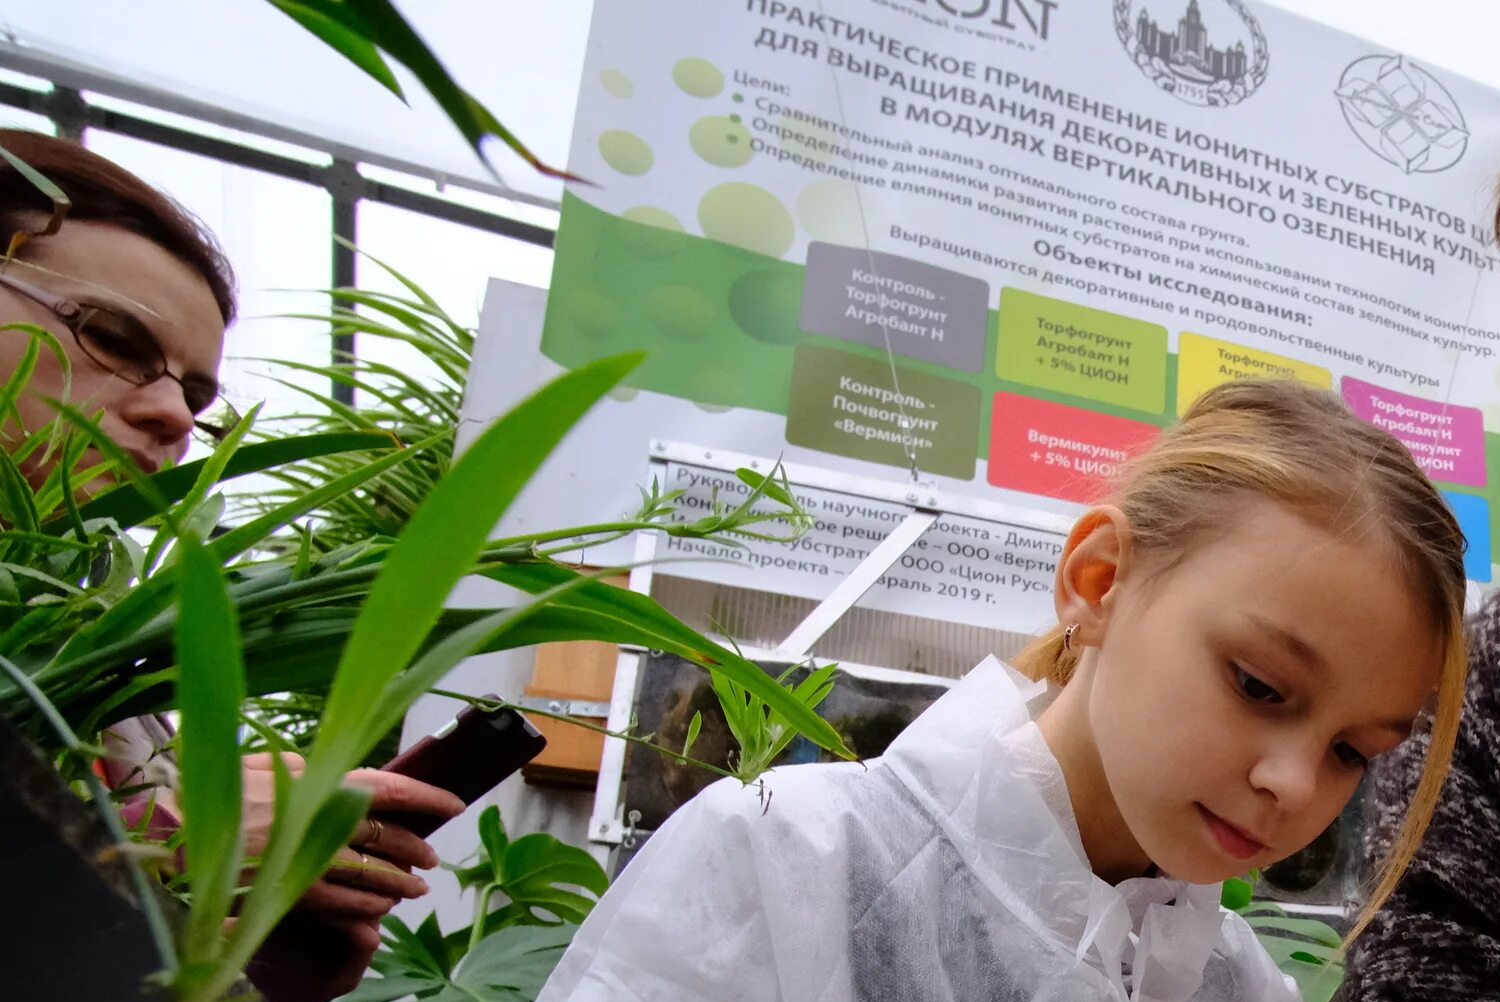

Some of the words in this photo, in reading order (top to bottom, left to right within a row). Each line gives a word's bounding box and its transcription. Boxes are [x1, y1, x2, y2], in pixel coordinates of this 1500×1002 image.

[733, 69, 792, 97] Цели:
[1176, 83, 1205, 100] 1755
[746, 0, 977, 79] ПРАКТИЧЕСКОЕ
[984, 64, 1168, 139] ПРИМЕНЕНИЕ
[1175, 126, 1318, 186] ИОНИТНЫХ
[1324, 173, 1466, 236] СУБСТРАТОВ
[753, 26, 819, 59] ДЛЯ
[827, 47, 1056, 131] ВЫРАЩИВАНИЯ
[1061, 118, 1272, 196] ДЕКОРАТИВНЫХ
[1279, 184, 1295, 204] И
[1302, 191, 1428, 247] ЗЕЛЕННЫХ
[754, 97, 913, 153] Сравнительный
[918, 145, 984, 171] анализ
[988, 162, 1117, 211] оптимального
[1120, 205, 1187, 231] состава
[1191, 224, 1251, 249] грунта.
[879, 96, 898, 117] В
[905, 103, 1045, 157] МОДУЛЯХ
[1052, 143, 1276, 224] ВЕРТИКАЛЬНОГО
[1283, 212, 1436, 276] ОЗЕЛЕНЕНИЯ
[752, 116, 889, 171] Определение
[891, 162, 989, 193] динамики
[993, 184, 1079, 220] развития
[1081, 208, 1164, 242] растений
[1167, 236, 1196, 258] при
[1201, 246, 1331, 292] использовании
[1335, 282, 1421, 321] технологии
[749, 137, 886, 190] Определение
[891, 180, 973, 208] влияния
[977, 199, 1068, 241] ионитных
[1072, 231, 1170, 269] субстратов
[1174, 258, 1195, 272] на
[1199, 266, 1299, 301] химический
[1303, 292, 1355, 317] состав
[1358, 308, 1430, 341] зеленных
[1433, 335, 1497, 358] культур.
[851, 268, 936, 302] Контроль
[1033, 239, 1142, 282] Объекты
[1148, 271, 1314, 328] исследования:
[844, 304, 928, 338] Агробалт
[845, 285, 949, 324] Торфогрунт
[889, 224, 1038, 279] Выращиваются
[1042, 268, 1174, 314] декоративные
[1178, 304, 1191, 318] и
[1194, 310, 1364, 366] продовольственные
[1368, 356, 1440, 389] культуры
[1036, 317, 1133, 351] Торфогрунт
[1036, 335, 1115, 366] Агробалт
[1050, 356, 1075, 376] 5%
[1079, 364, 1129, 386] ЦИОН
[839, 375, 926, 411] Контроль
[1370, 395, 1454, 426] Торфогрунт
[832, 394, 940, 433] Почвогрунт
[1372, 413, 1440, 440] Агробалт
[833, 418, 934, 451] «Вермион»
[1027, 428, 1128, 462] Вермикулит
[1045, 452, 1072, 469] 5%
[926, 518, 990, 542] роекта
[1004, 531, 1063, 557] Дмитр
[667, 536, 743, 562] Начало
[748, 551, 829, 577] проекта
[875, 575, 932, 593] враль
[937, 581, 981, 602] 2019
[985, 592, 997, 605] г.
[781, 525, 871, 562] убстрат
[900, 554, 944, 575] ООО
[949, 564, 1006, 588] «Цион
[1010, 573, 1055, 595] Рус».
[946, 541, 990, 561] ООО
[994, 553, 1056, 574] «Верти
